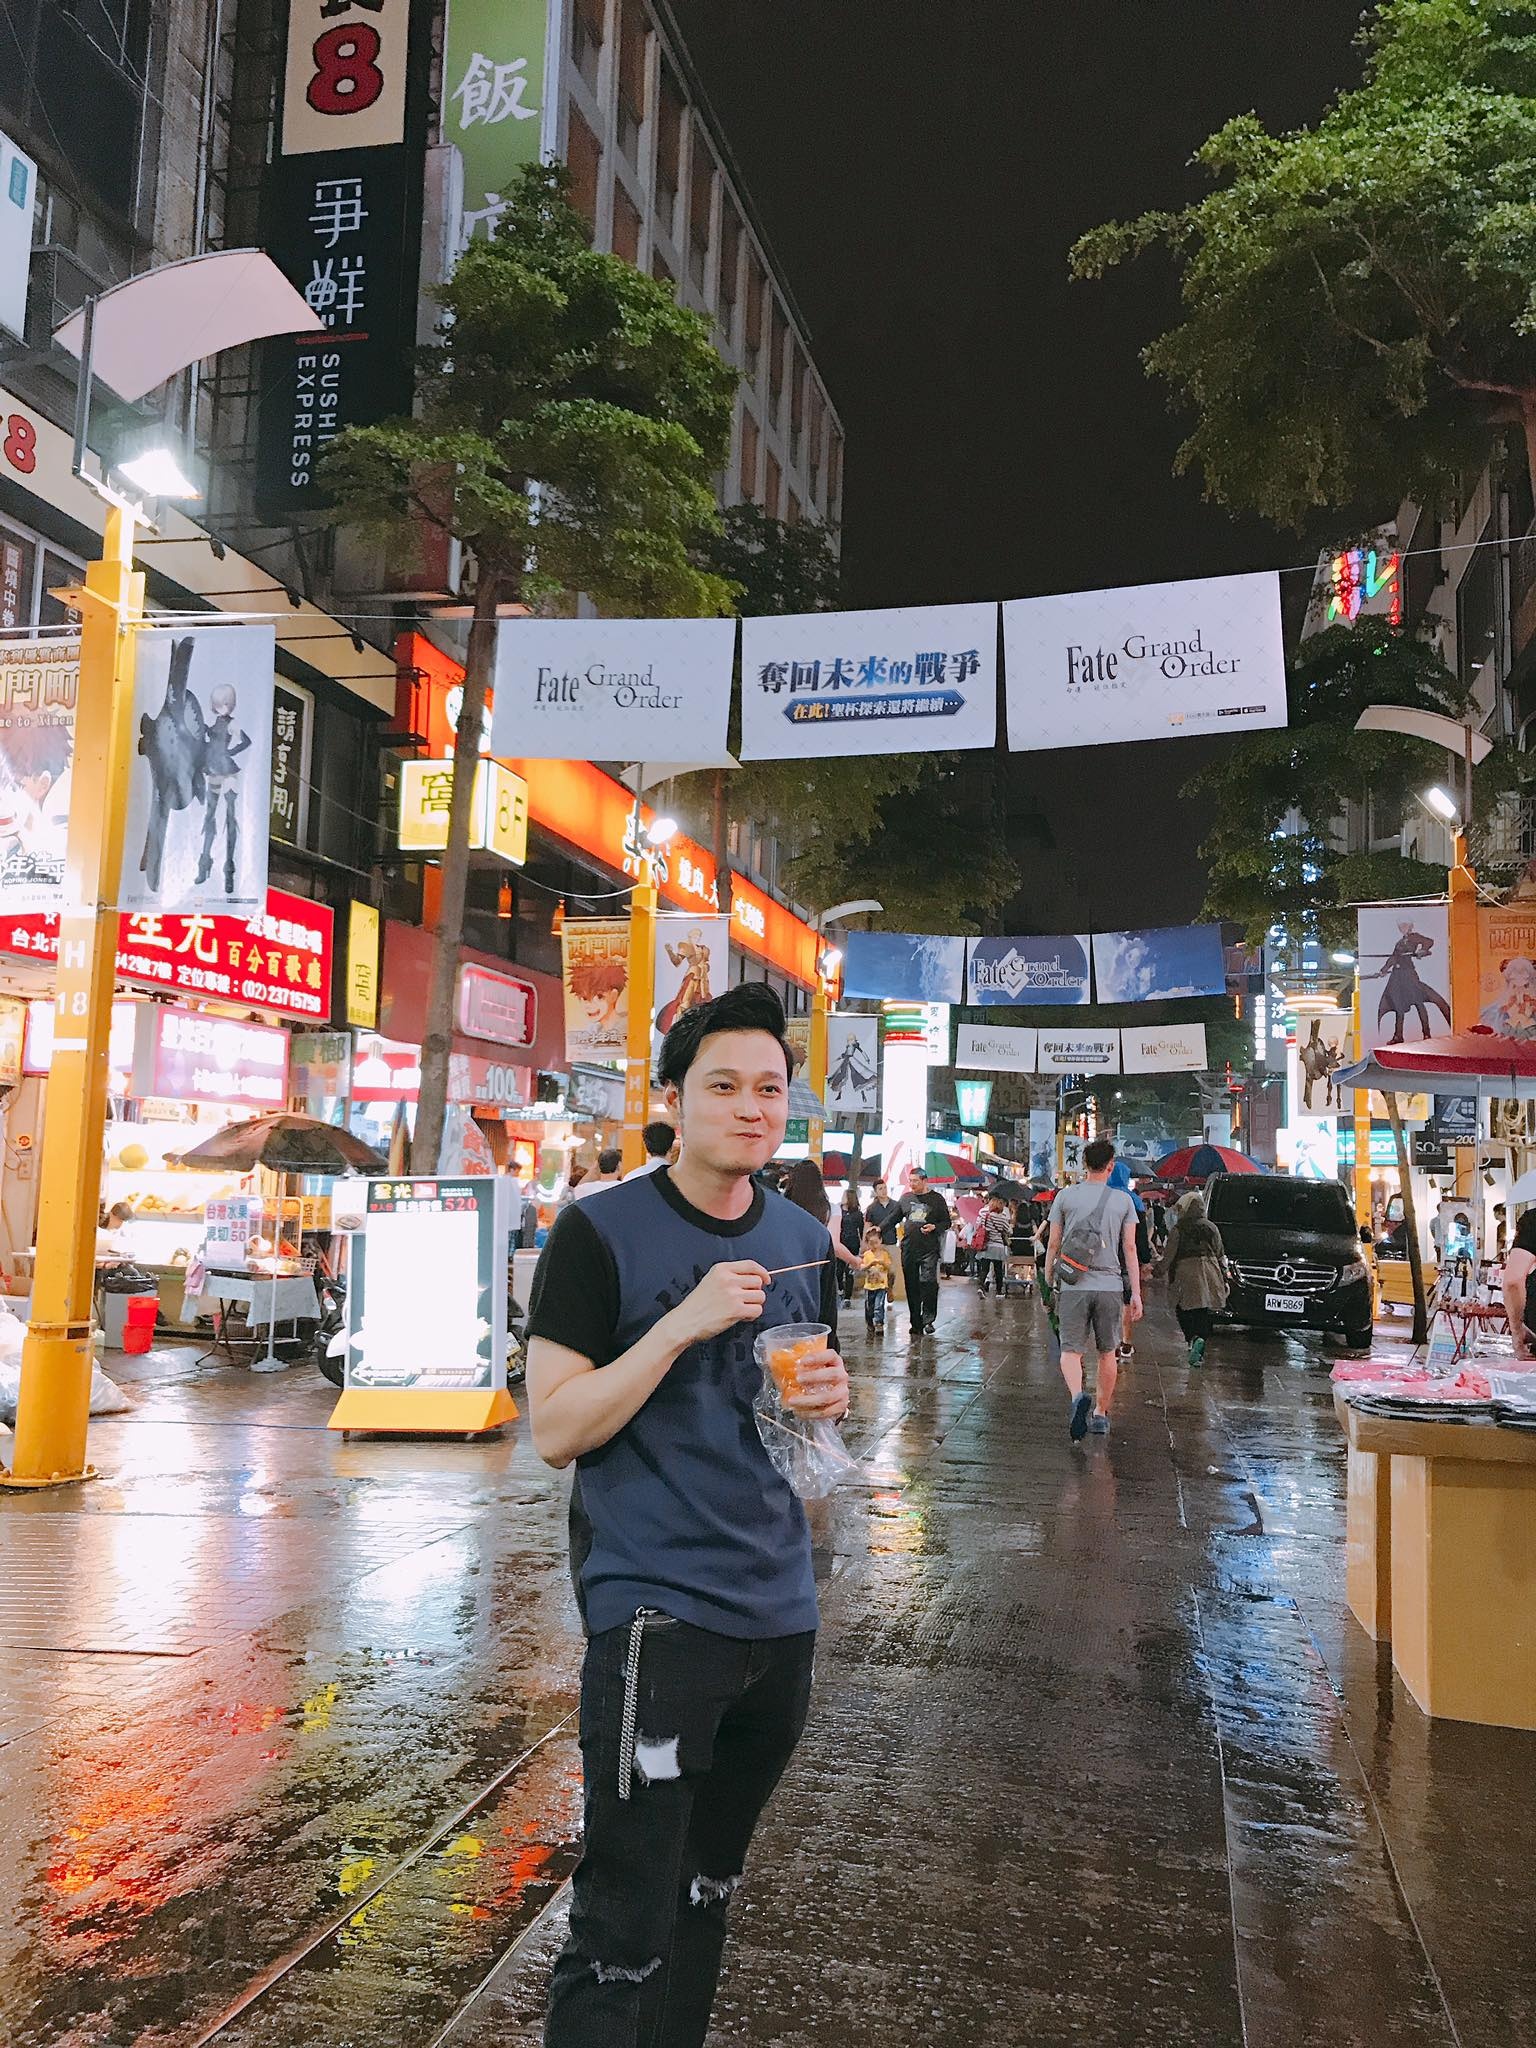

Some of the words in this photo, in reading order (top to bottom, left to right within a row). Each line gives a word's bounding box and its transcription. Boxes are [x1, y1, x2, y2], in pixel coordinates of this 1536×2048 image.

[306, 0, 385, 116] 8
[305, 178, 369, 326] 爭鮮
[318, 353, 341, 441] SUSHI
[290, 355, 317, 487] EXPRESS
[1121, 629, 1205, 659] Grand
[584, 664, 655, 686] Grand
[757, 648, 981, 694] 奪回未來的戰爭
[1066, 645, 1118, 685] Fate
[1159, 650, 1241, 679] Order
[0, 667, 80, 712] 門町
[536, 667, 580, 703] Fate
[613, 685, 685, 709] Order
[66, 940, 86, 969] H
[1009, 955, 1061, 973] Grand
[973, 958, 1006, 985] Fate
[1033, 971, 1084, 988] Order
[57, 991, 88, 1017] 18
[971, 1040, 988, 1053] Fate
[1141, 1042, 1158, 1055] Fate
[207, 1203, 248, 1220] 台灣水果
[445, 1197, 478, 1211] 520
[231, 1231, 246, 1242] 50
